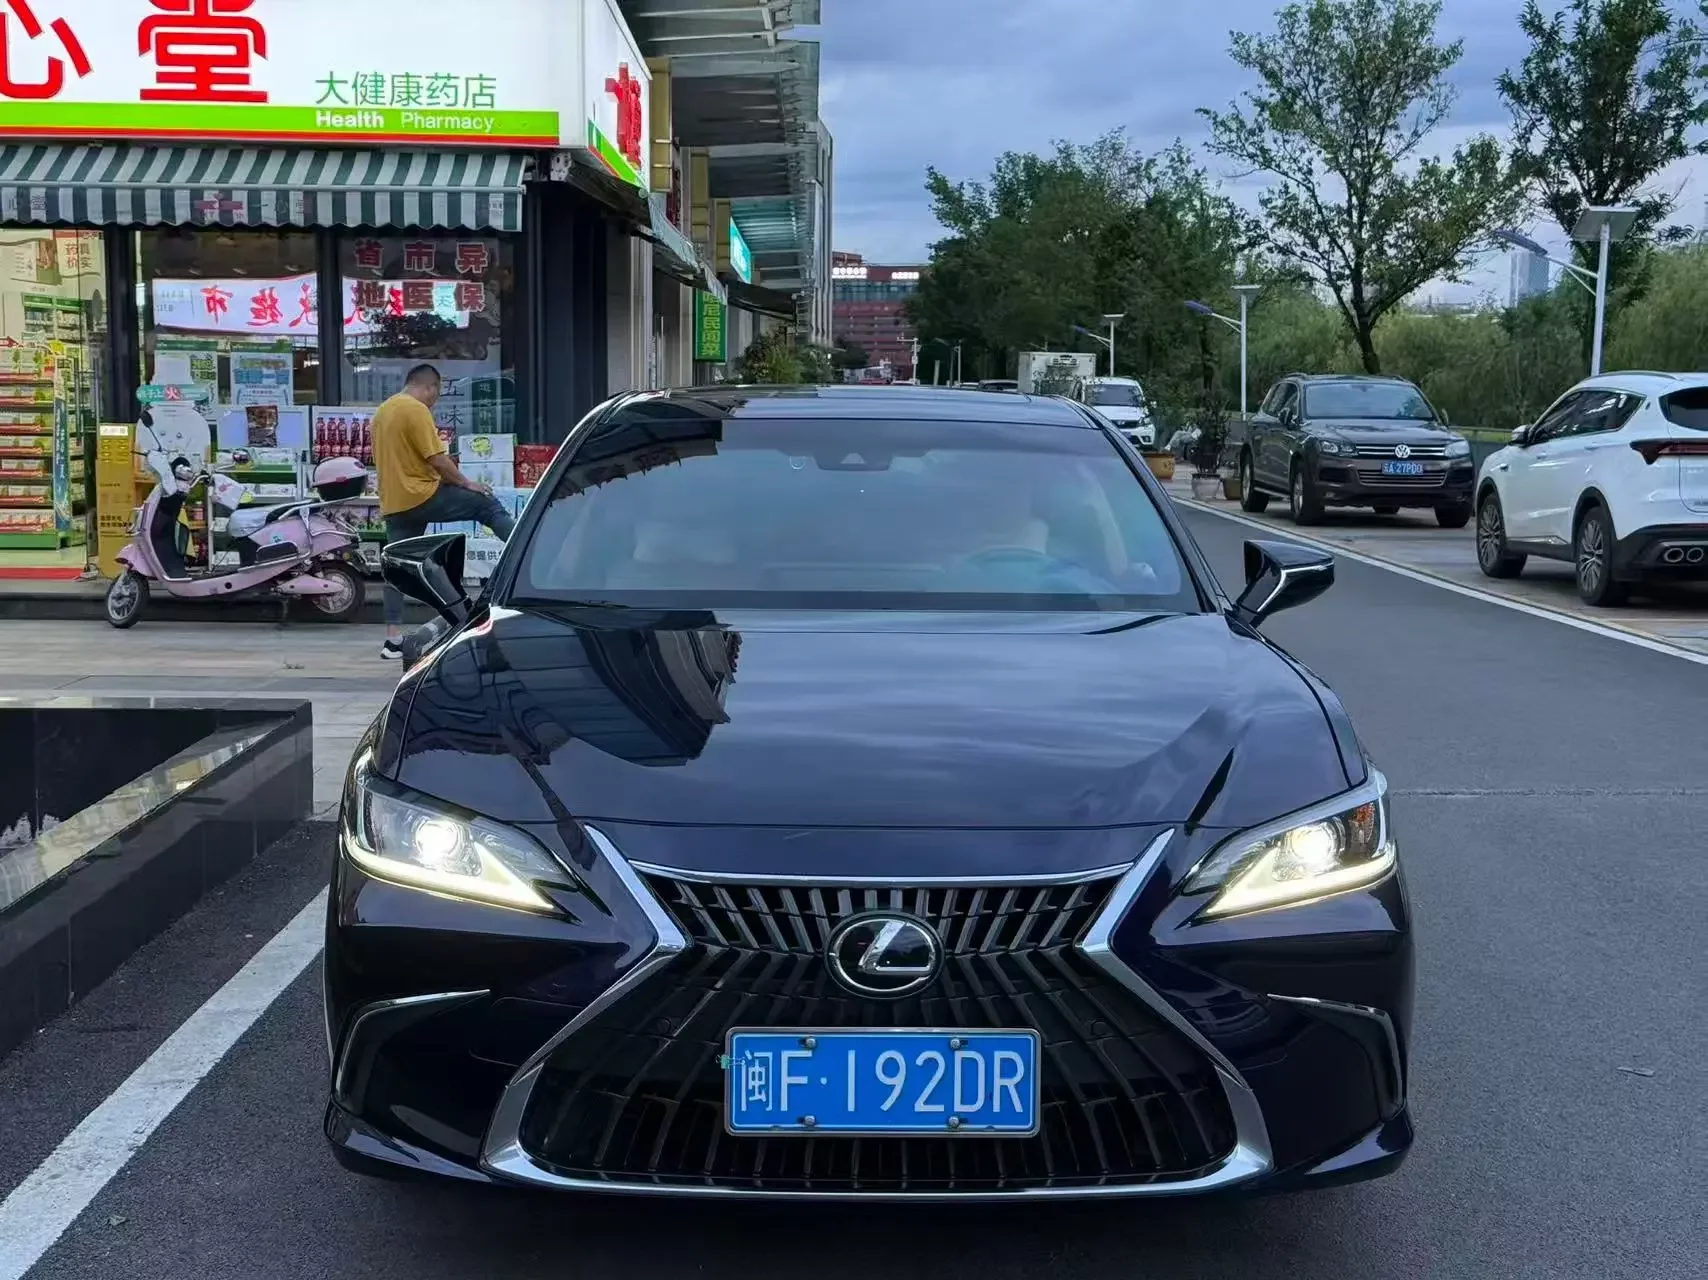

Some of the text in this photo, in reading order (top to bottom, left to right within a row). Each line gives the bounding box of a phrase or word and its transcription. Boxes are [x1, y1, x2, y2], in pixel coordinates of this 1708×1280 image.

[315, 71, 497, 108] 大健康药店
[315, 111, 495, 133] Health Pharmacy
[740, 1050, 1026, 1112] 闽F·192DR
